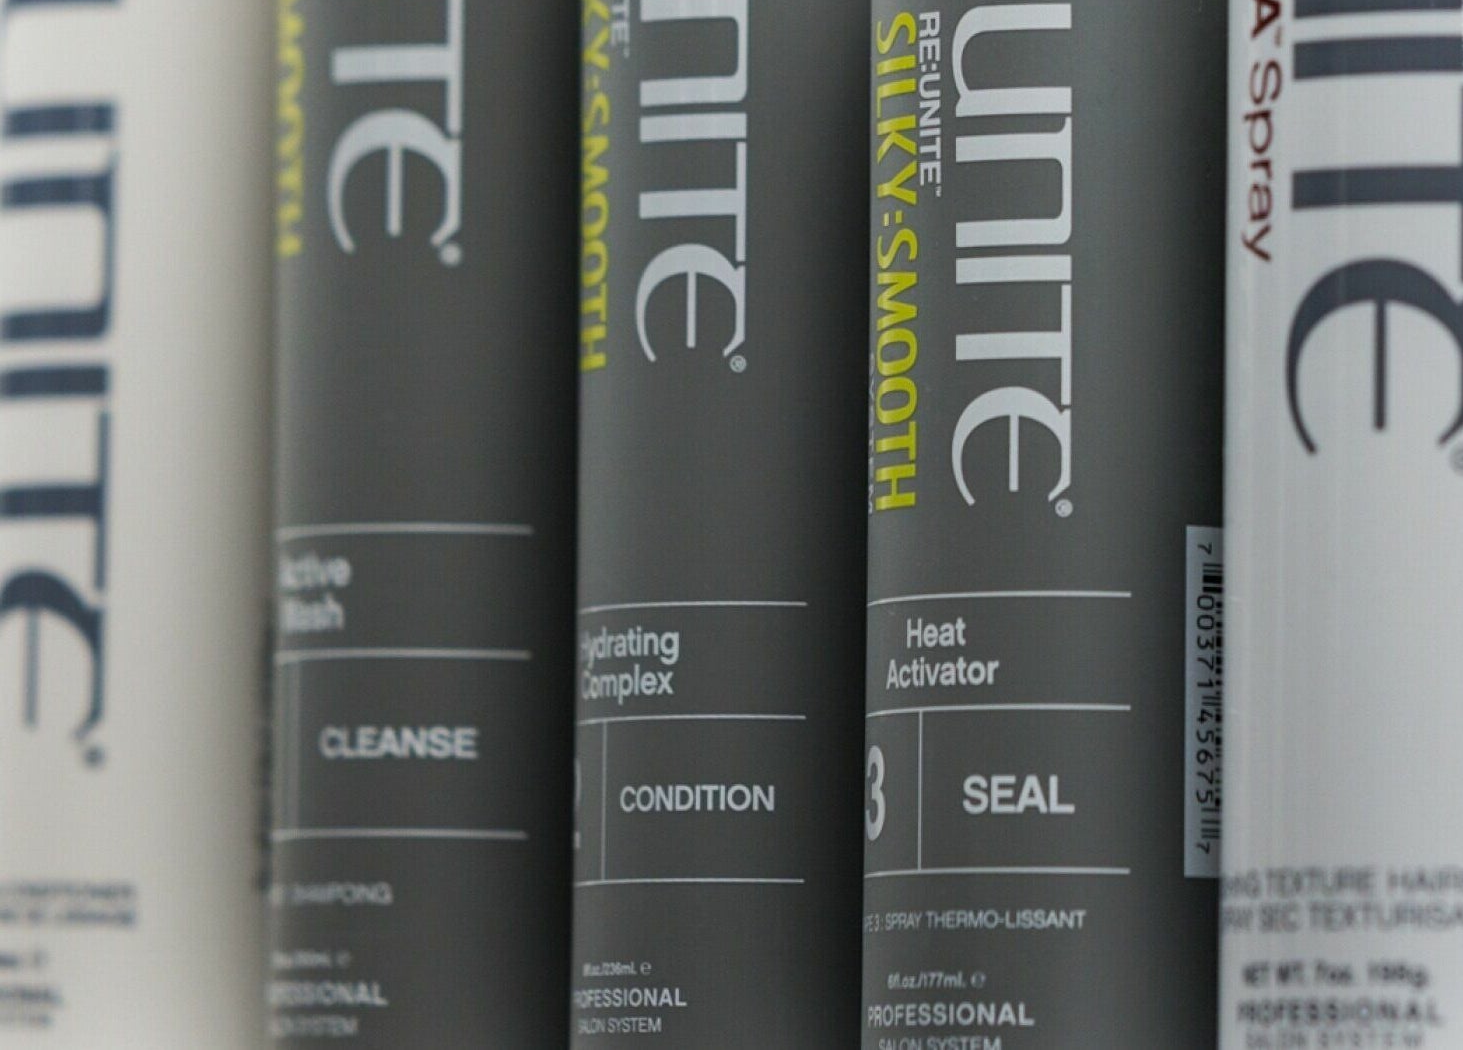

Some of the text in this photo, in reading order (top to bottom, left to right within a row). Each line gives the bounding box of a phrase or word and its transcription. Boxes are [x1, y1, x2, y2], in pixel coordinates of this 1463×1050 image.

[917, 11, 942, 187] RE:UNITE
[1240, 57, 1281, 264] Spray
[874, 12, 918, 511] SILKY:SMOOTH
[906, 617, 966, 649] Heat
[579, 664, 674, 706] Complex
[886, 657, 999, 691] Activator
[319, 726, 479, 759] CLEANSE
[619, 784, 776, 813] CONDITION
[866, 746, 886, 840] 3
[962, 775, 1075, 814] SEAL
[1266, 867, 1376, 896] TEXTURE
[885, 911, 921, 931] SPRAY
[926, 908, 1087, 930] THERMO-LISSANT
[607, 1017, 662, 1034] SYSTEM
[867, 1002, 1035, 1027] PROFESSIONAL
